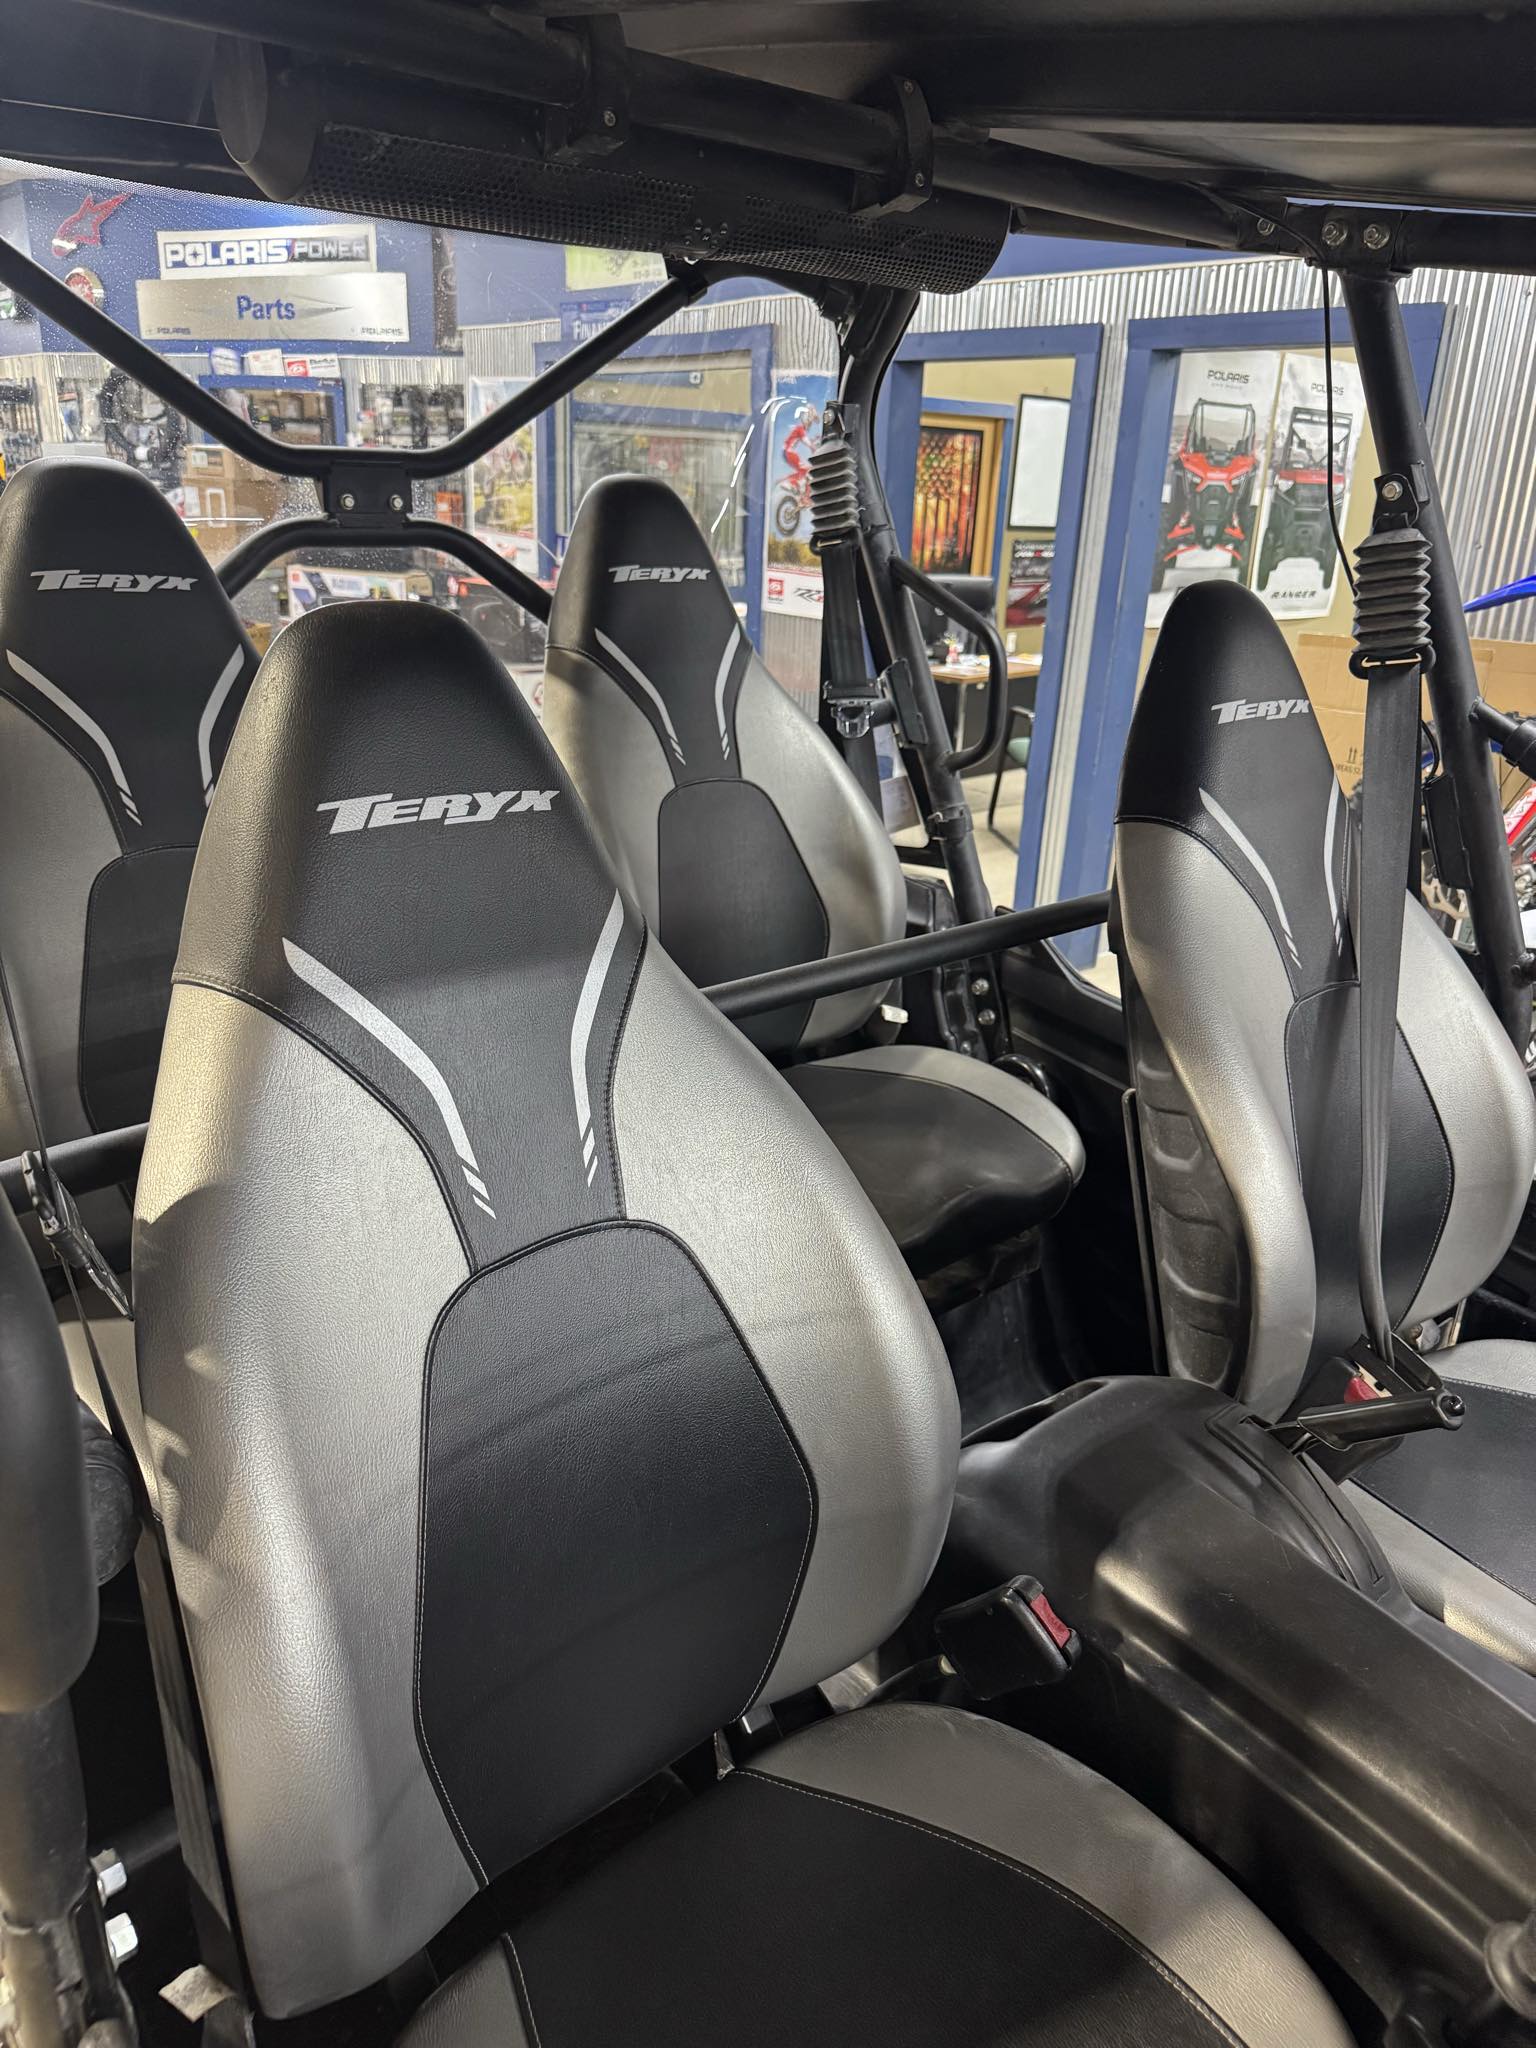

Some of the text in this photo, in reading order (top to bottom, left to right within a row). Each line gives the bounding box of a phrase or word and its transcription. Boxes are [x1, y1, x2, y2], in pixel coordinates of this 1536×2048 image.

[166, 236, 368, 269] POLARIS POWER
[236, 295, 296, 320] Parts
[1207, 369, 1250, 384] POLARIS
[1311, 382, 1344, 396] POLRIS
[30, 569, 199, 592] TERYX
[608, 564, 711, 583] TERYX
[1271, 590, 1316, 600] RANGER
[1210, 698, 1310, 725] TERYX
[316, 790, 560, 835] TERYX
